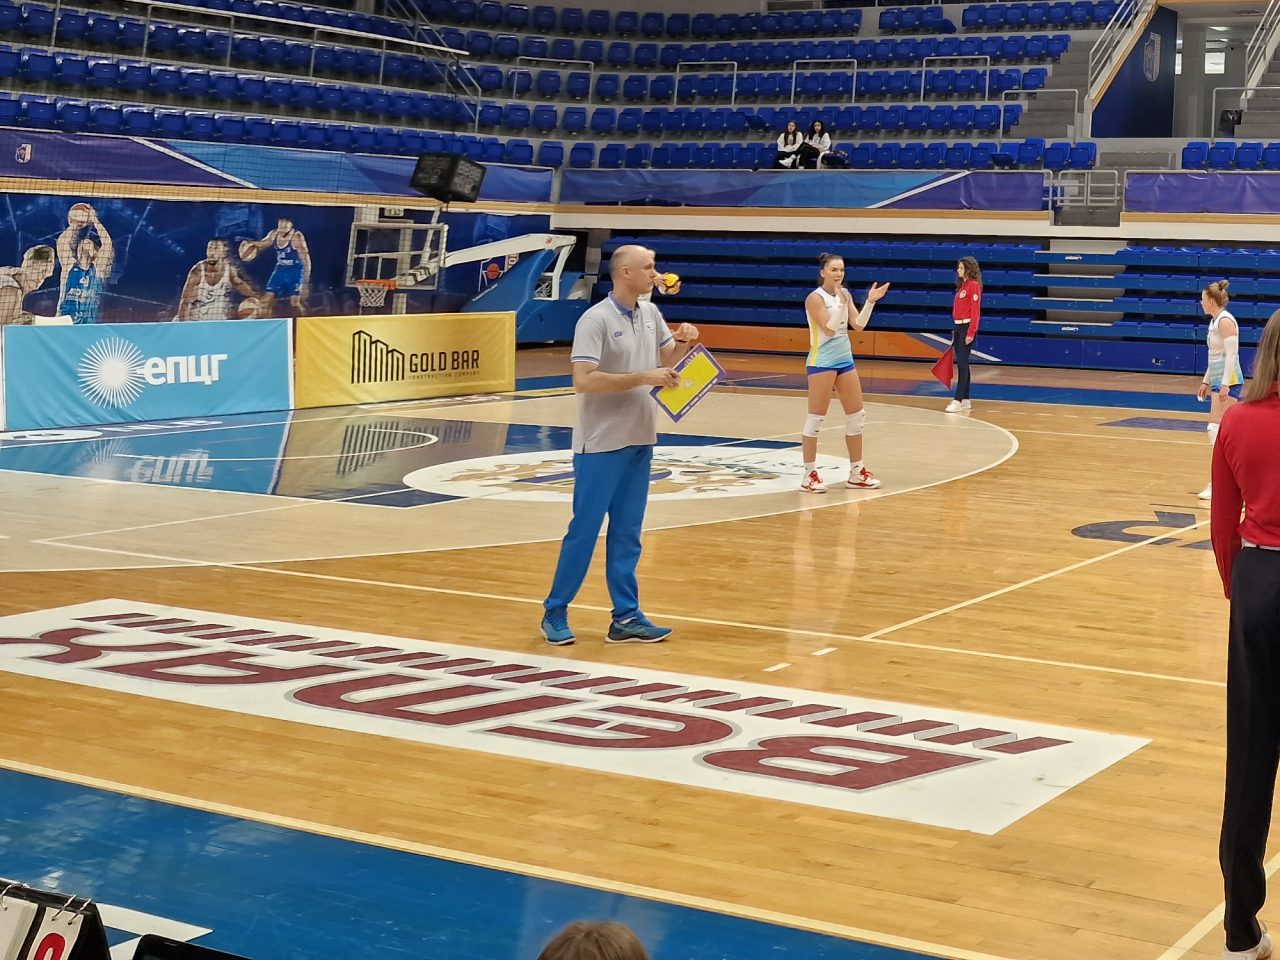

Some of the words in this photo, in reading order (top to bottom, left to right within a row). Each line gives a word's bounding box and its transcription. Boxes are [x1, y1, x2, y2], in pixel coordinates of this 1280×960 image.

[144, 353, 228, 385] епцг
[409, 351, 447, 373] GOLD
[451, 349, 480, 370] BAR
[0, 627, 986, 793] BEMAX
